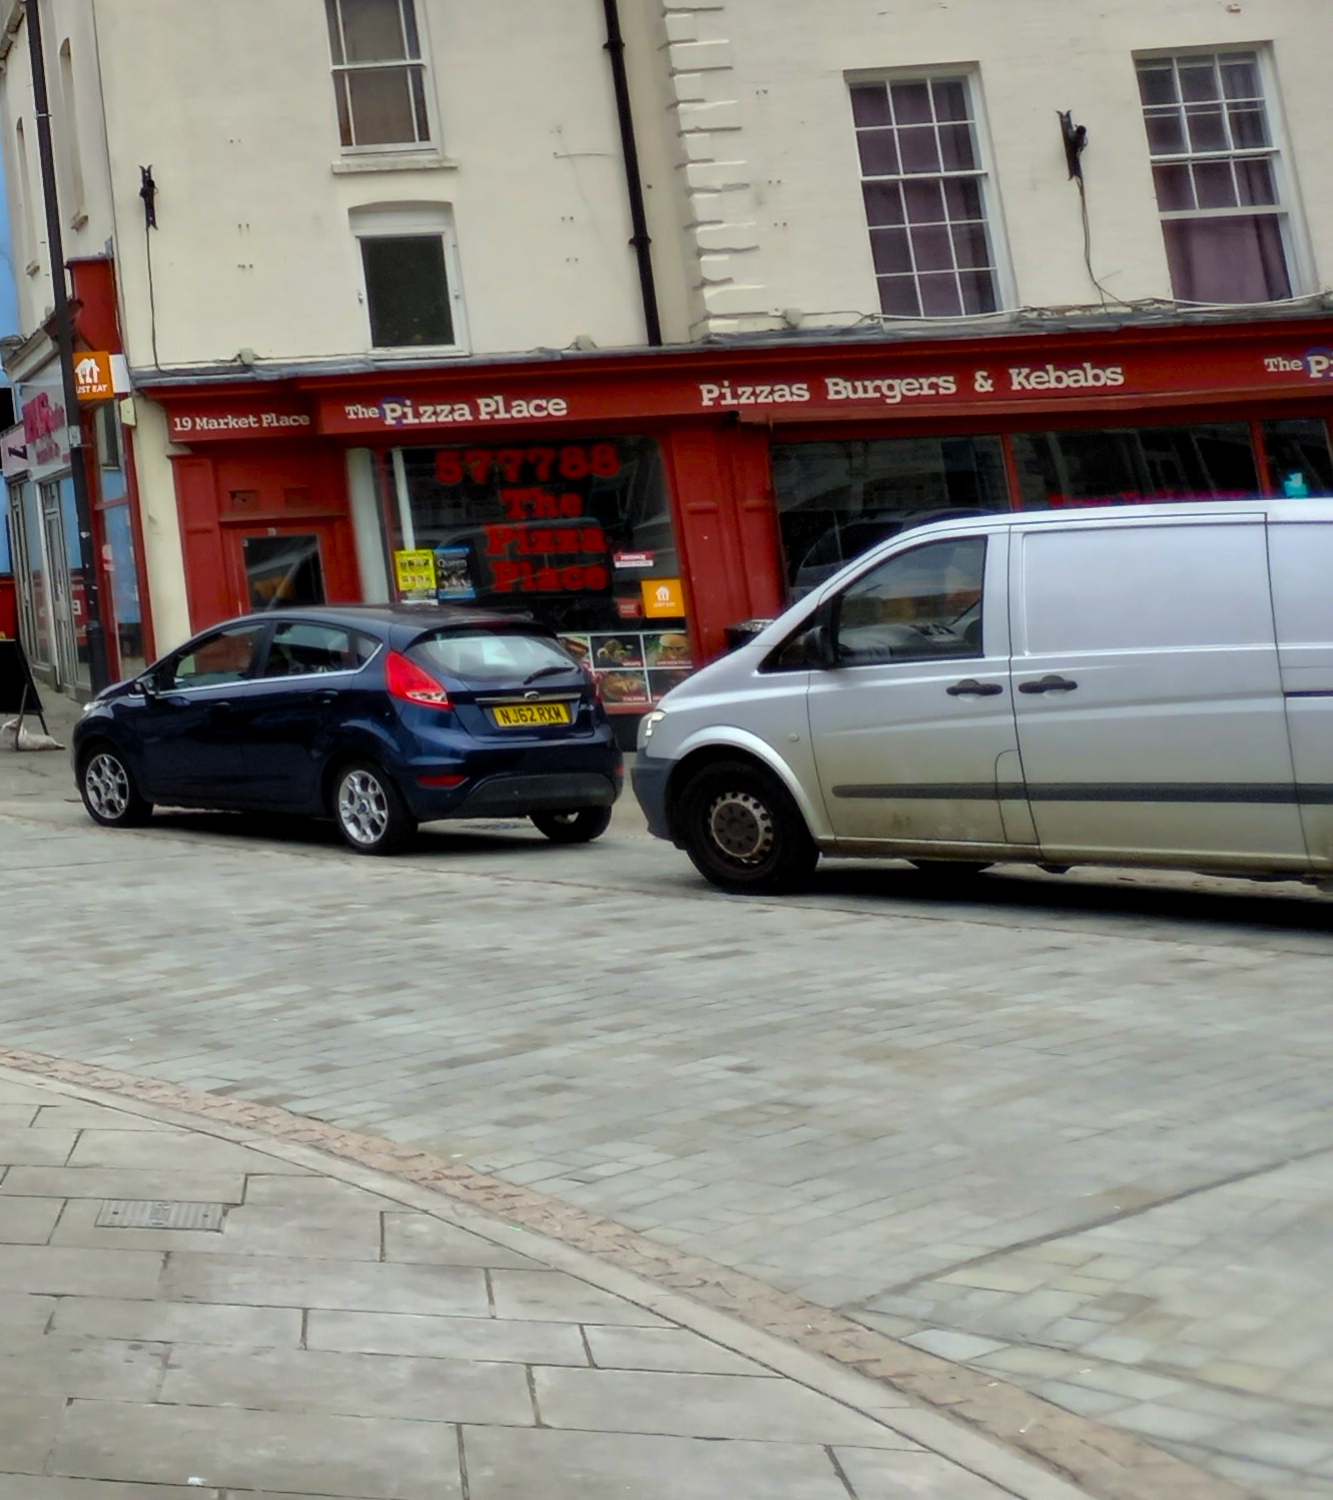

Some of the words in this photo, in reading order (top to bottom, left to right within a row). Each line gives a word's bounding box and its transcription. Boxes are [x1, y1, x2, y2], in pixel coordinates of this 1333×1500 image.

[1264, 356, 1303, 372] The
[92, 383, 108, 393] EAT
[699, 380, 811, 406] Pizzas
[824, 374, 957, 404] Burgers
[974, 370, 994, 392] &
[1009, 363, 1125, 391] Kebabs
[174, 416, 192, 432] 19
[195, 412, 259, 431] Market
[261, 412, 311, 428] Place
[345, 404, 380, 420] The
[382, 400, 471, 426] Pizza
[476, 395, 568, 420] Place
[435, 442, 622, 485] 577788
[501, 486, 583, 519] The
[485, 523, 608, 554] Pizza
[490, 560, 609, 593] Place
[499, 708, 538, 725] NJ62
